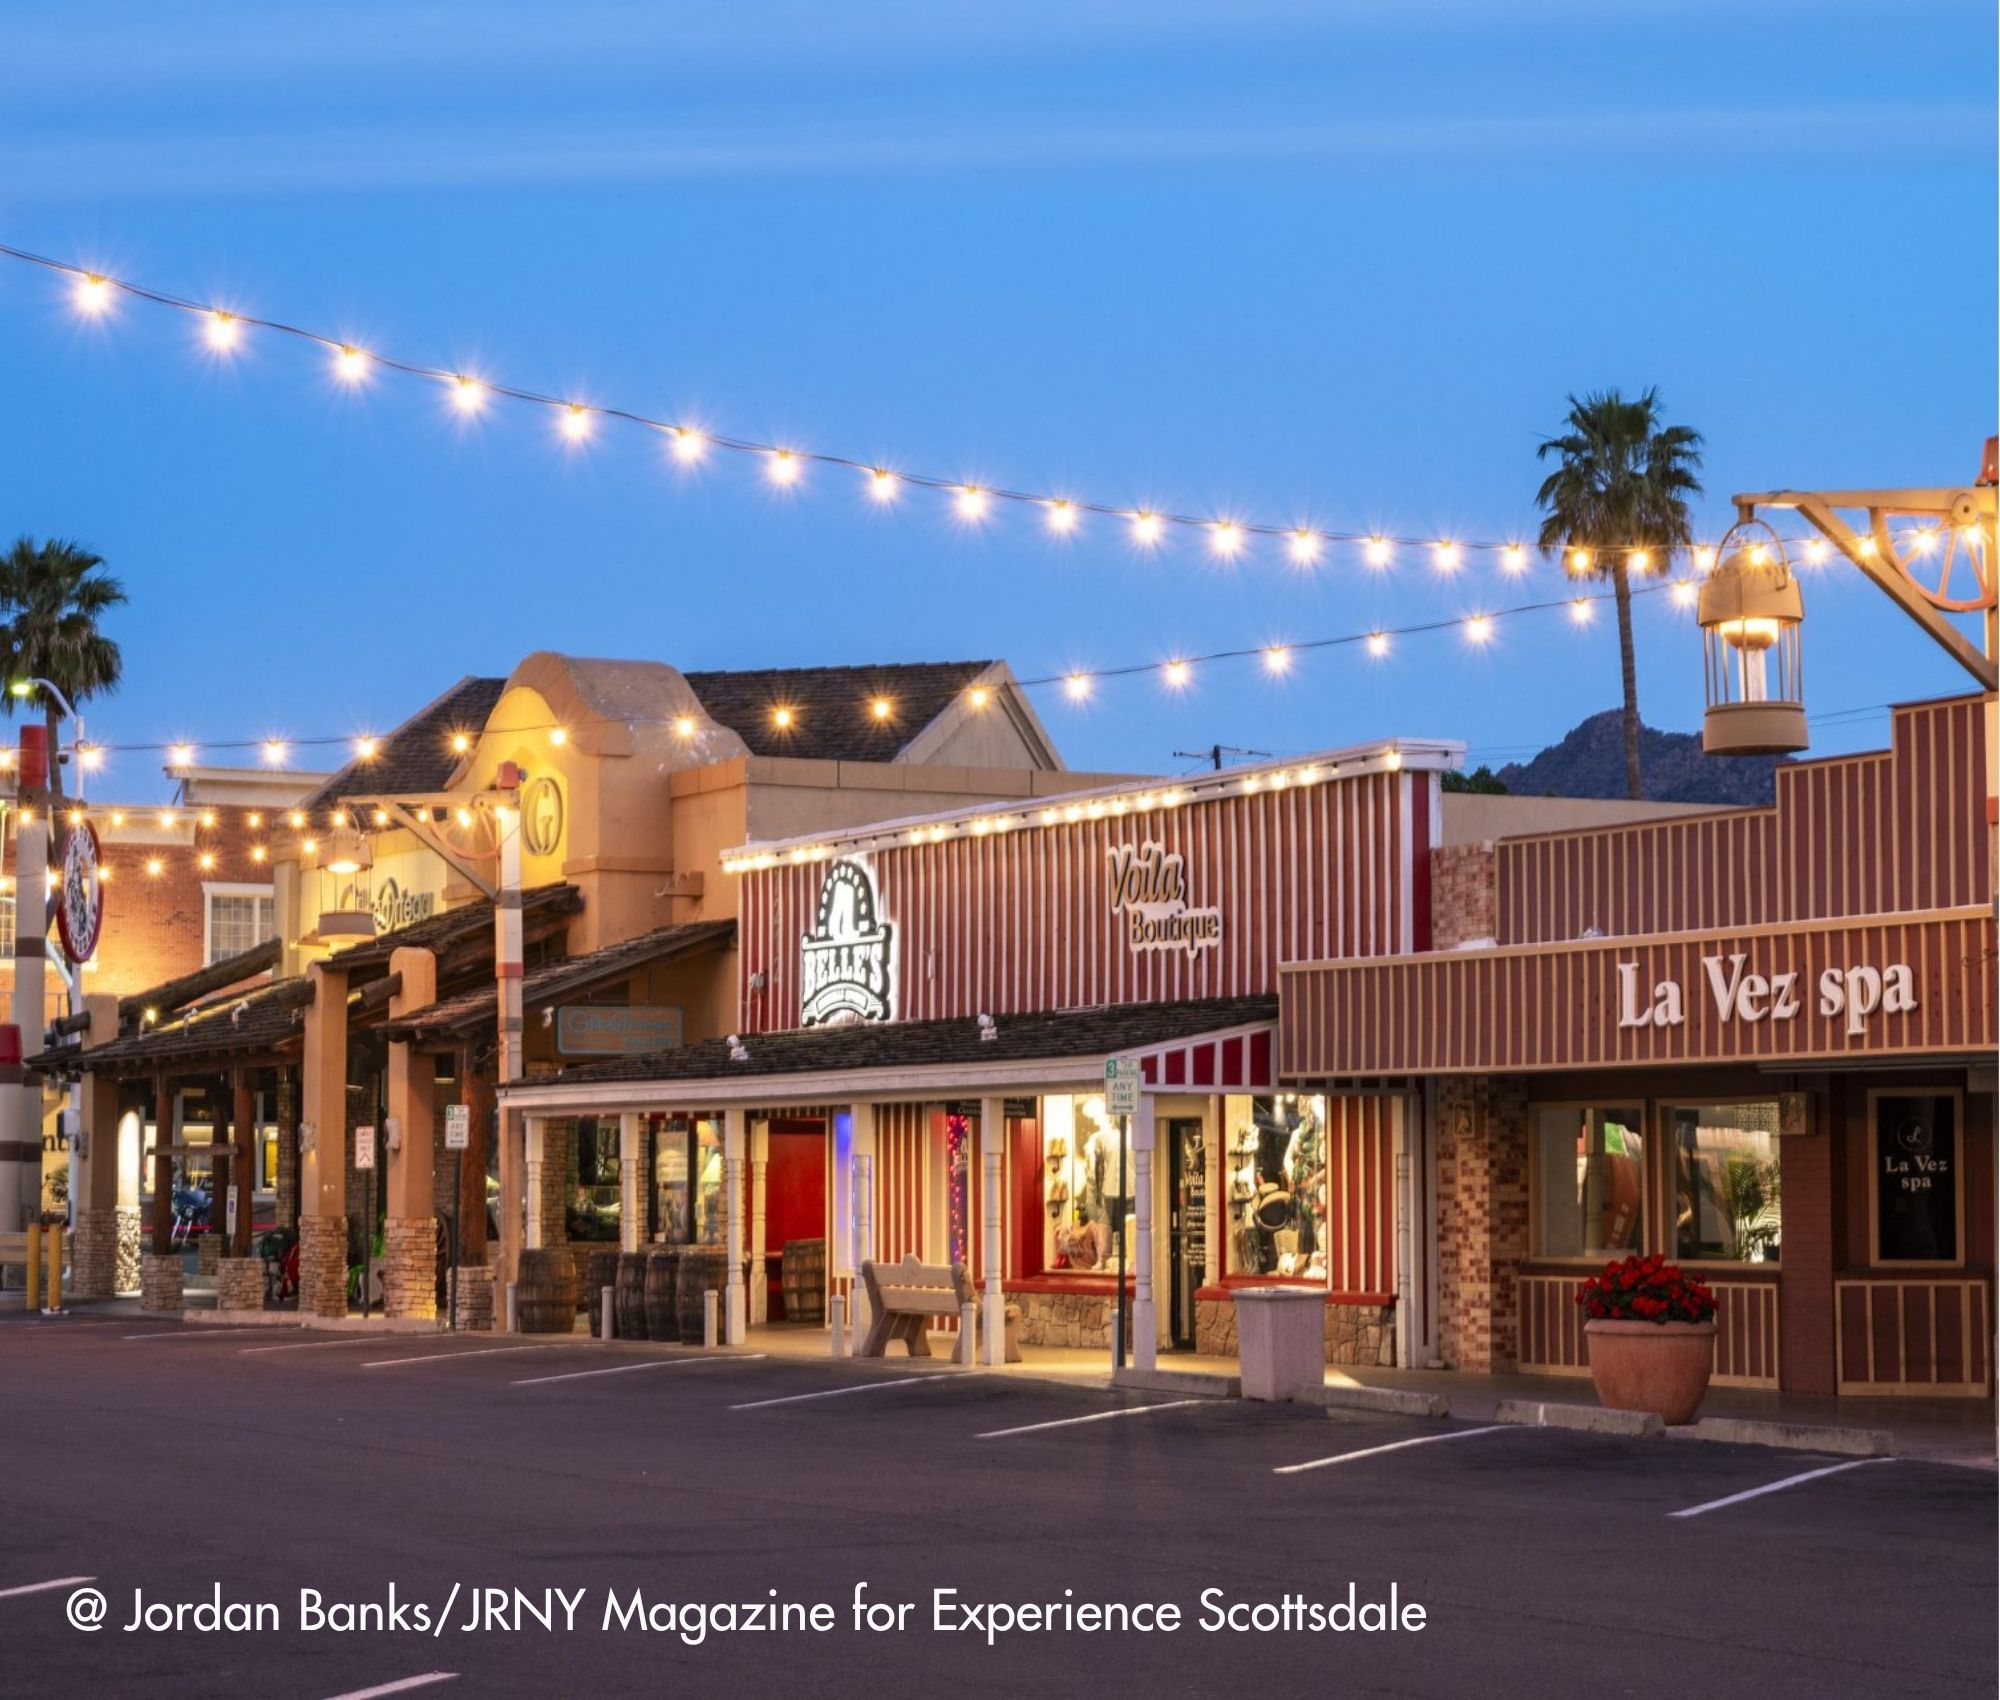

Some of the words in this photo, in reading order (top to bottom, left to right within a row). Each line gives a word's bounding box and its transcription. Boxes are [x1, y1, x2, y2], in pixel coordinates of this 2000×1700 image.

[1107, 847, 1181, 908] Voila
[1131, 908, 1219, 951] Boutique
[804, 943, 885, 1002] BELLE'S
[1617, 962, 1685, 1027] La
[1702, 953, 1800, 1022] Vez
[1819, 963, 1918, 1035] spa
[1107, 1061, 1116, 1078] 3
[1113, 1081, 1133, 1091] ANY
[1112, 1092, 1134, 1102] TIME
[1885, 1156, 1909, 1172] La
[1914, 1155, 1948, 1172] Vez
[1901, 1176, 1932, 1193] spa
